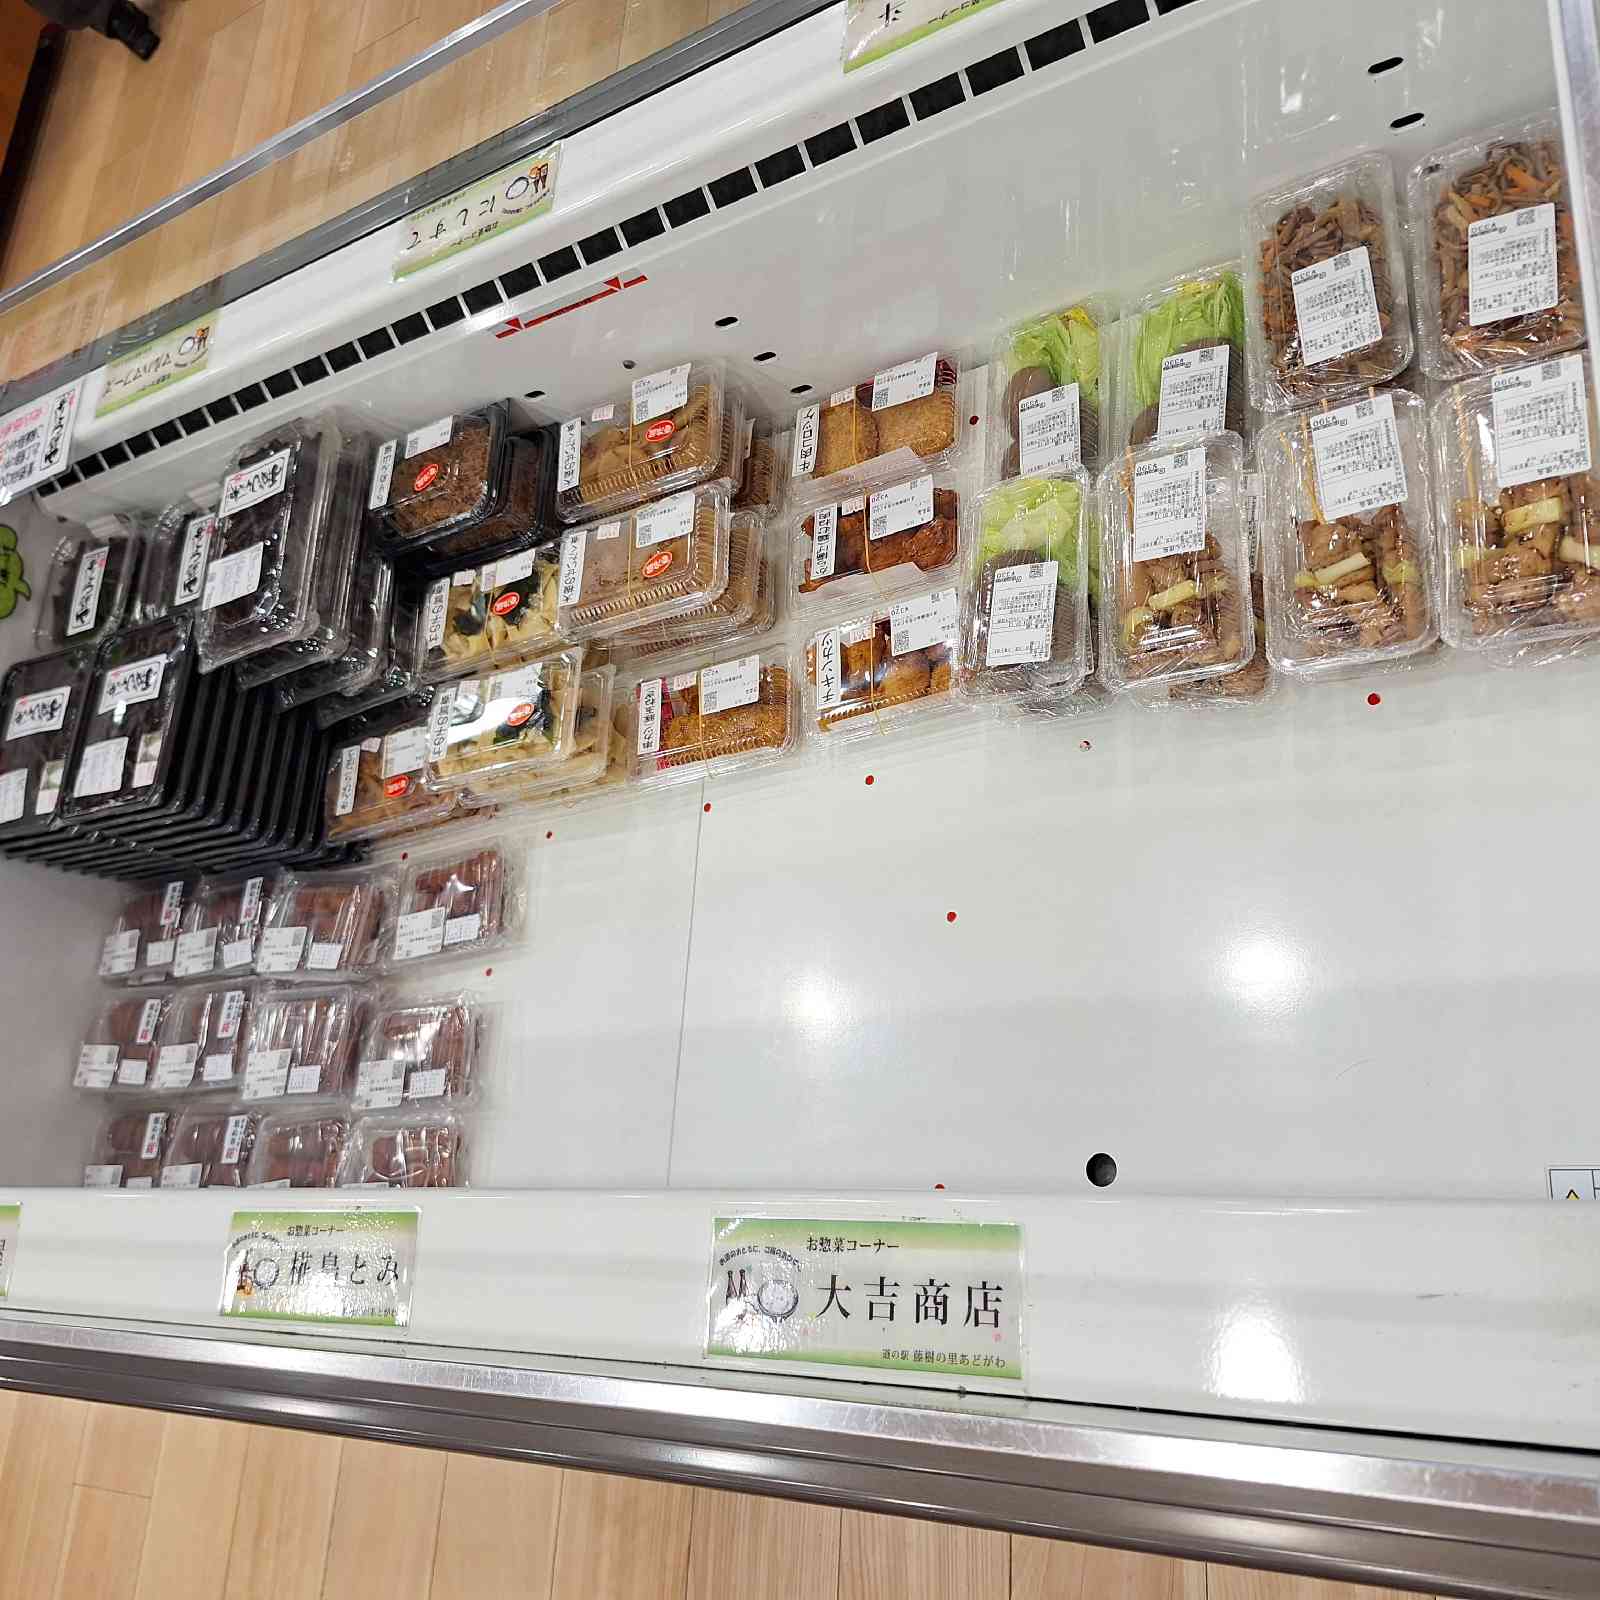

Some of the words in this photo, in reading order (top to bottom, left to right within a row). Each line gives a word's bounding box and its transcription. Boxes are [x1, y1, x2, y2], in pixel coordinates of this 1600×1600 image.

[799, 407, 816, 472] 牛肉コロッケ
[819, 631, 837, 703] チキンカツ
[806, 1236, 901, 1253] お惣菜コーナー
[815, 1273, 1004, 1329] 大吉商店
